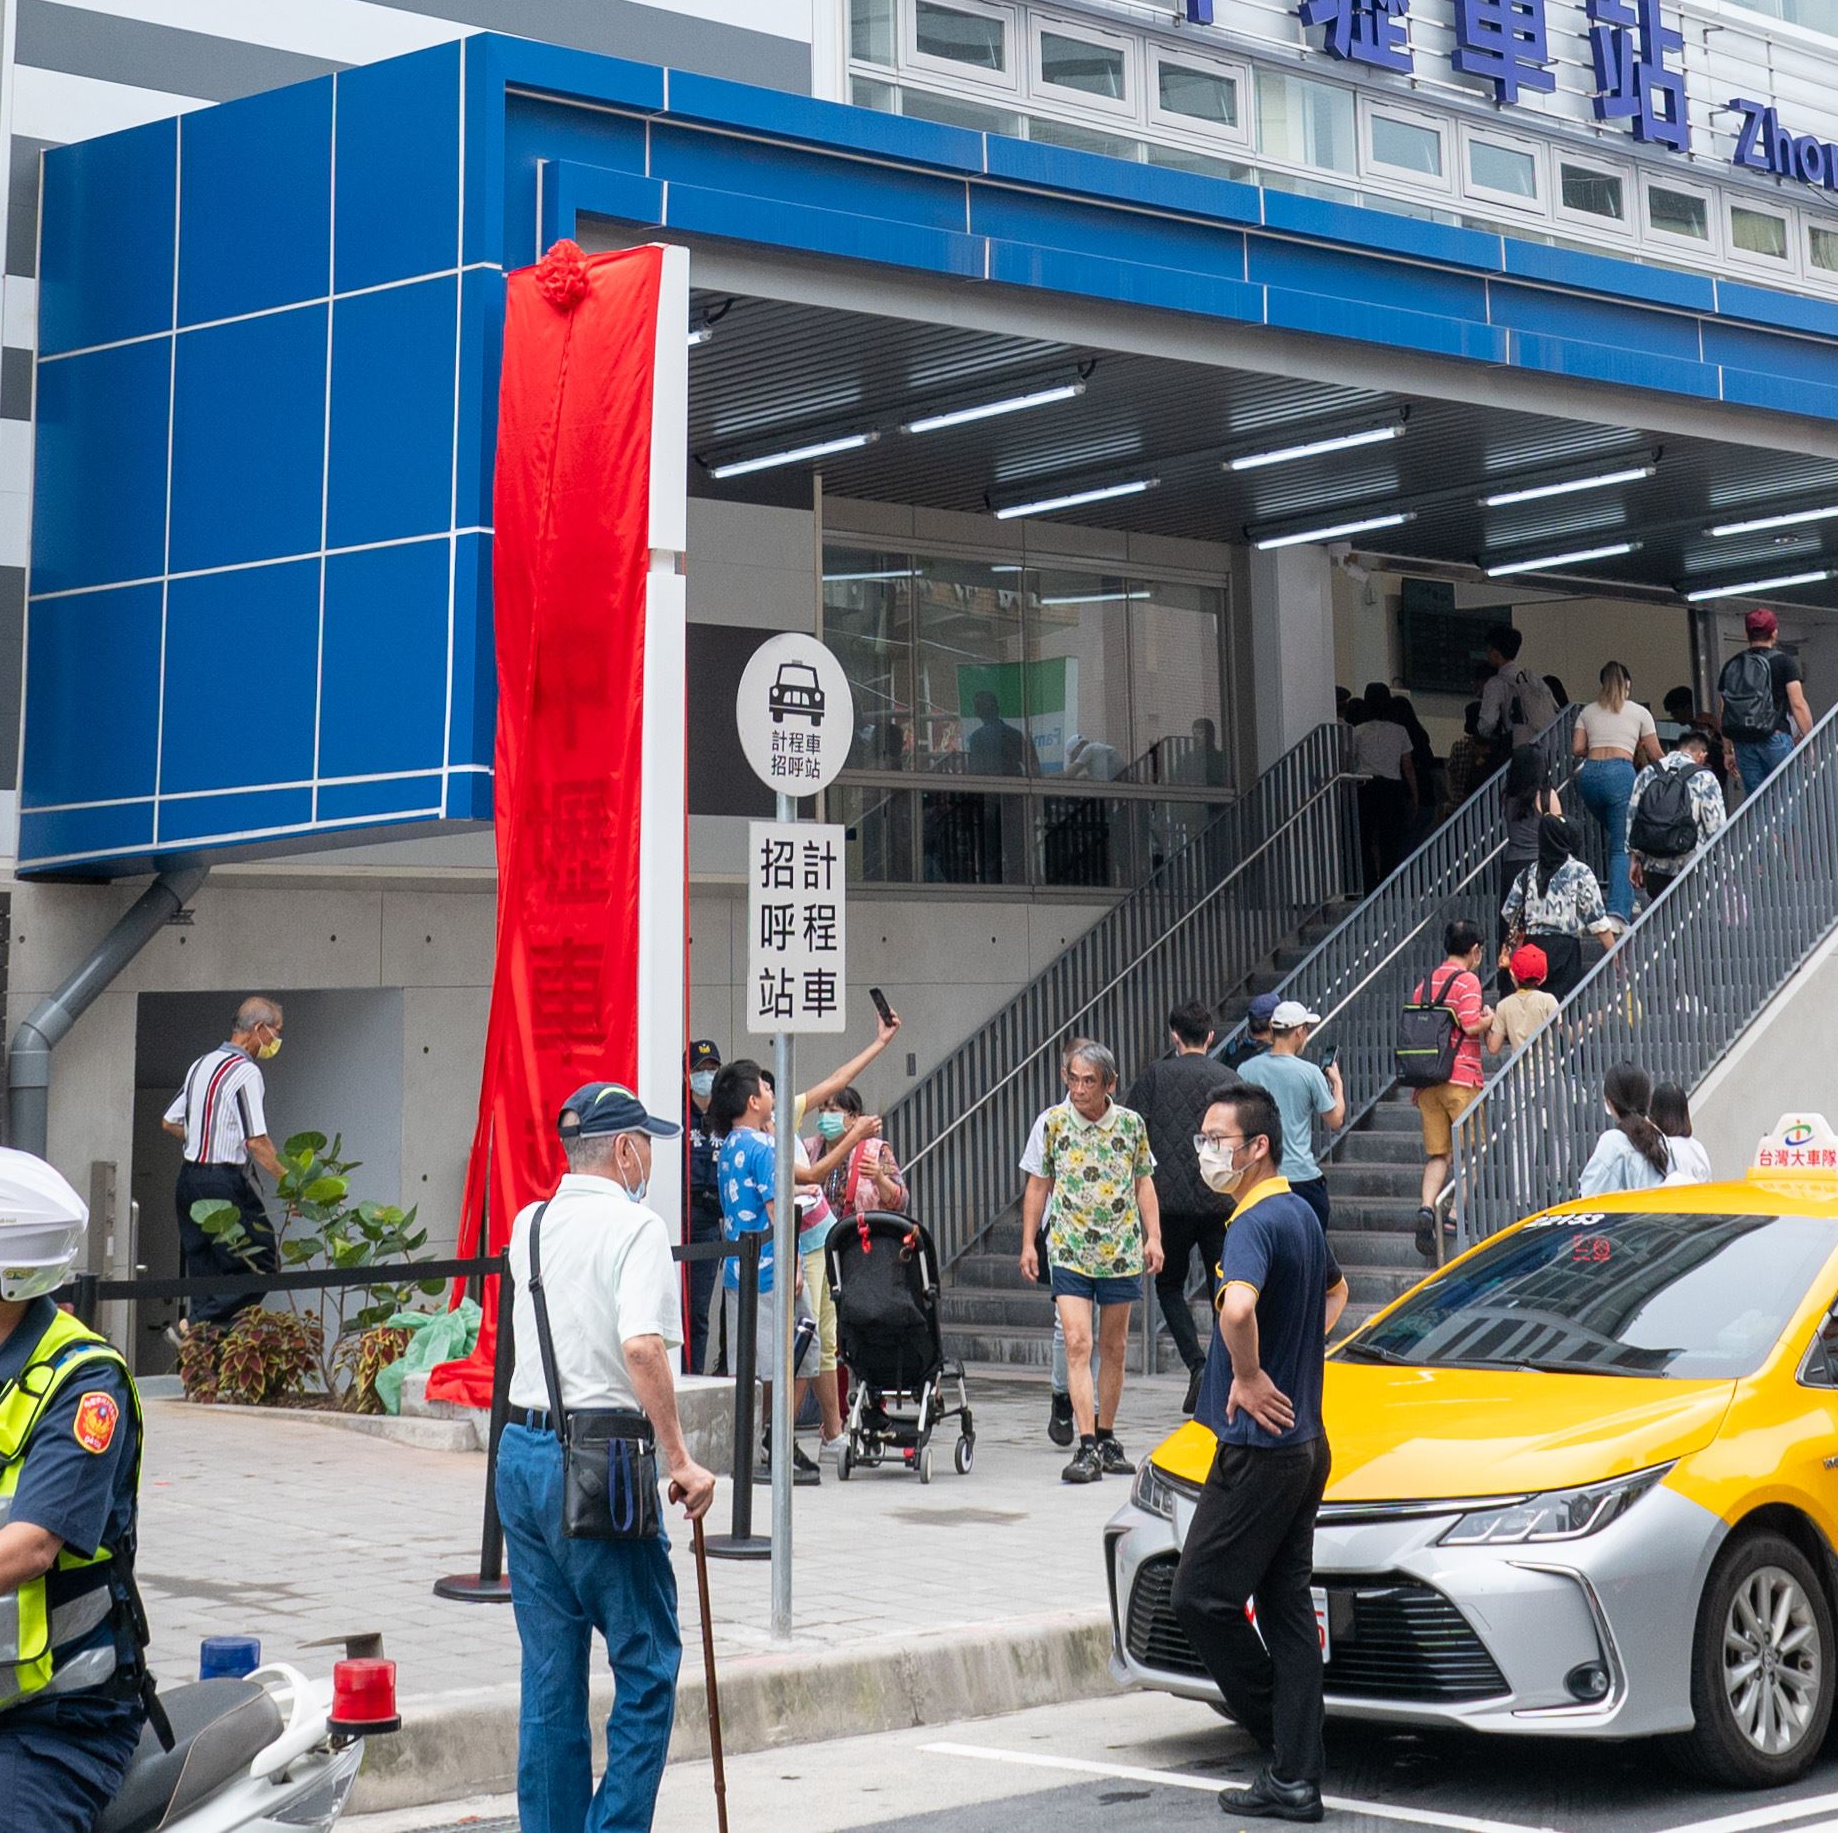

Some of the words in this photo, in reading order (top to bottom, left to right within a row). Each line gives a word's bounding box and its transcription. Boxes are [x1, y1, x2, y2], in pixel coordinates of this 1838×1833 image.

[772, 730, 821, 754] 計程車
[771, 756, 821, 779] 招呼站
[759, 837, 795, 1019] 招呼站
[803, 839, 837, 1018] 計程車
[1760, 1149, 1837, 1167] 台灣大車隊
